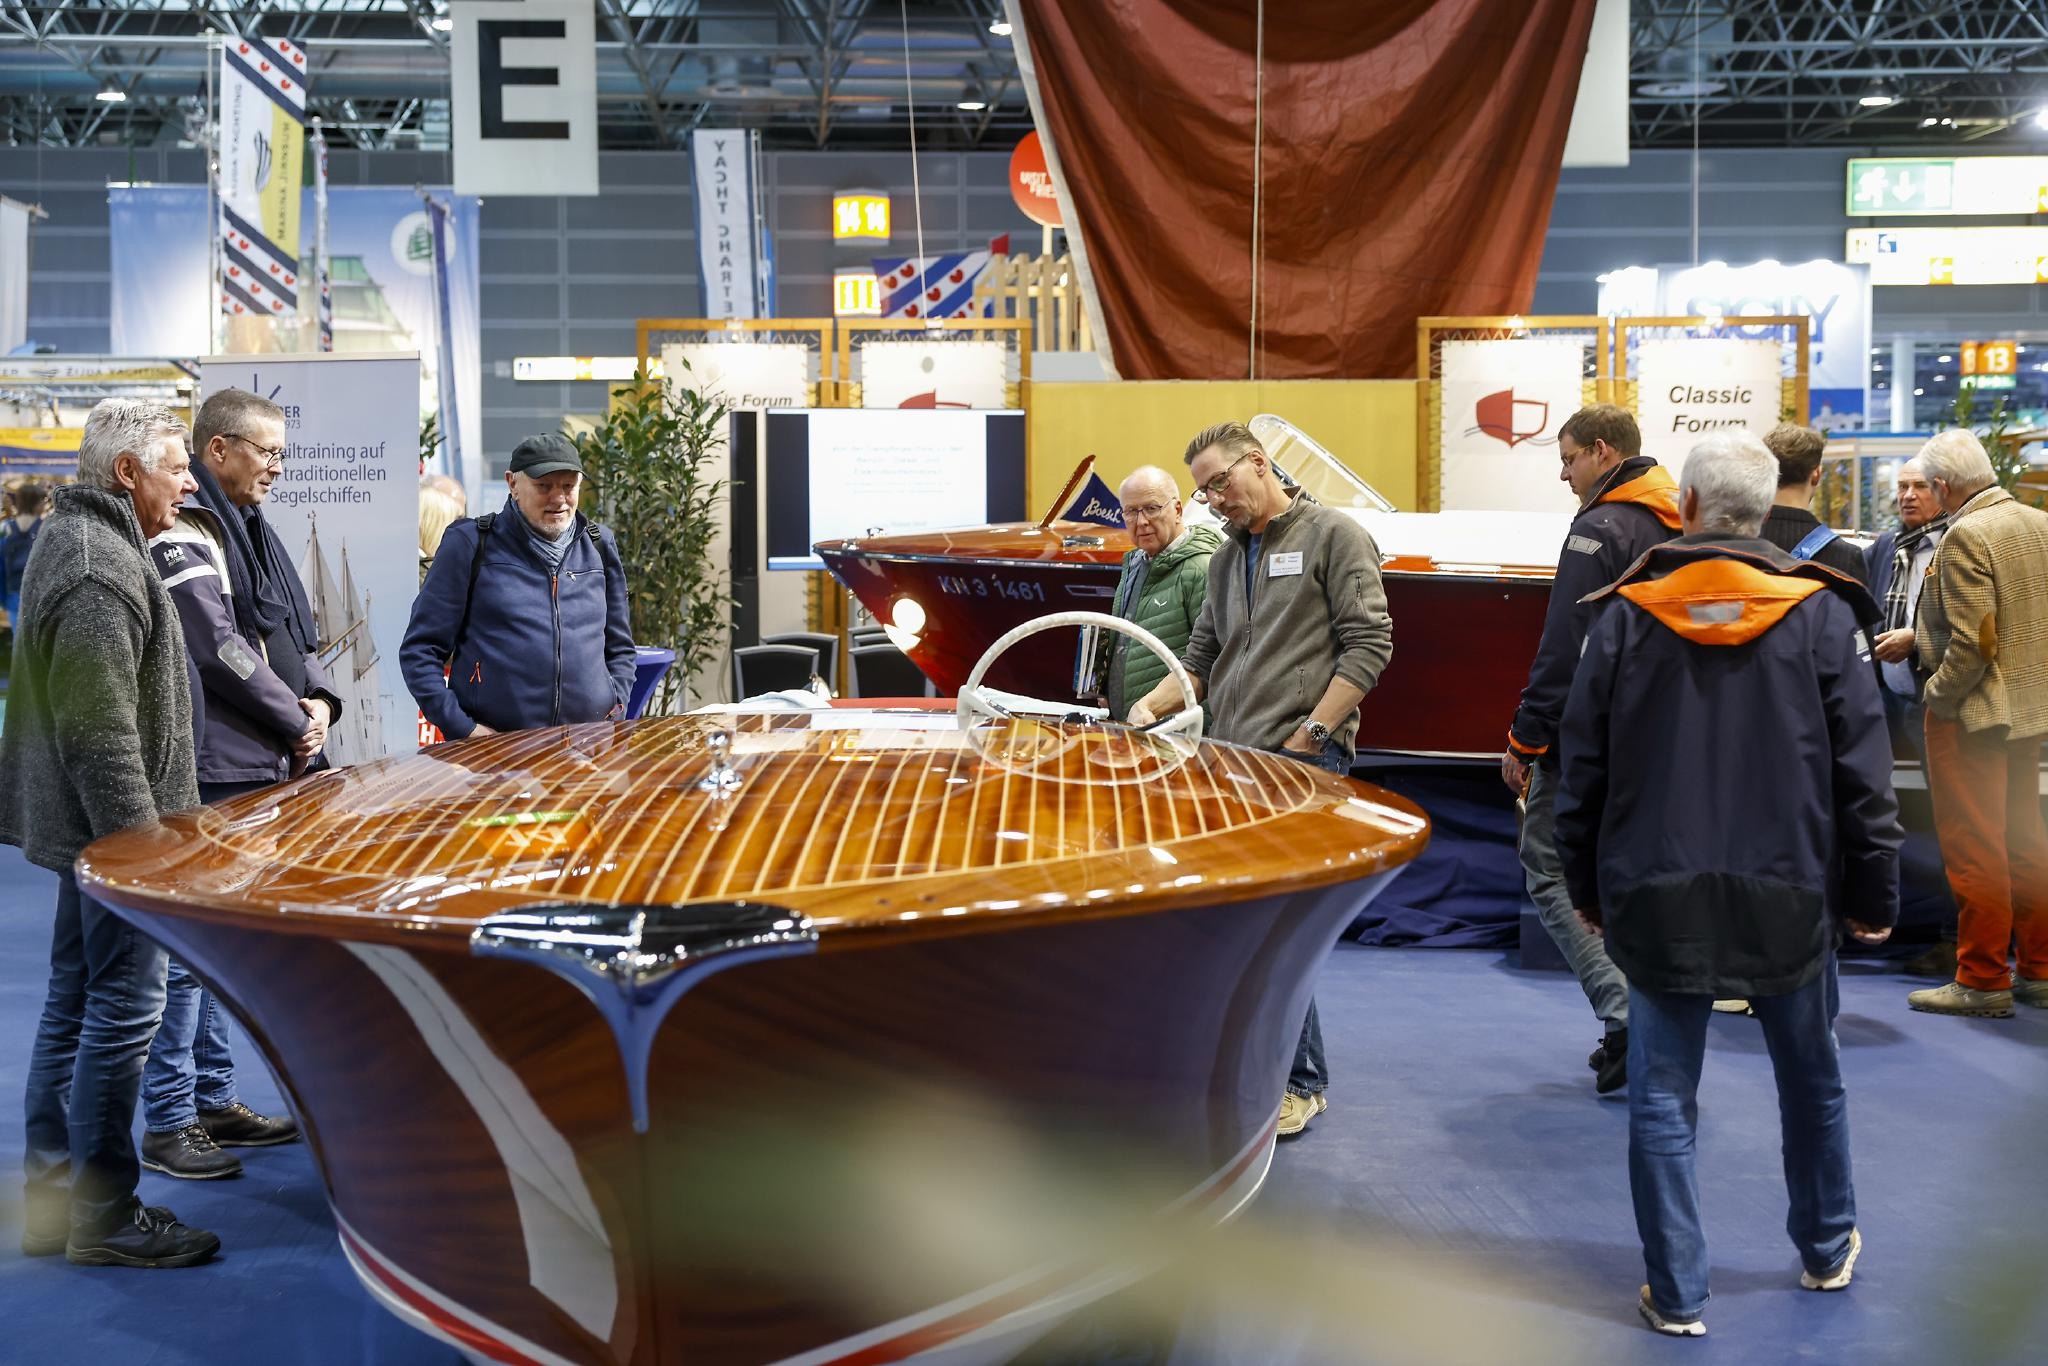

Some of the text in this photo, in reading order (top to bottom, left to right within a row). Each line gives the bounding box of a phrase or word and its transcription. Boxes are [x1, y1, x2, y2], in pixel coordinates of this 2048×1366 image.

[478, 20, 570, 139] E
[836, 200, 887, 233] 14 14
[1984, 346, 2010, 373] 13
[742, 393, 792, 407] Forum
[1669, 384, 1753, 405] Classic
[281, 441, 386, 463] ailtraining auf
[284, 463, 387, 481] traditionellen
[271, 486, 371, 507] Segelschiffen
[938, 575, 1046, 602] KN 3 1461
